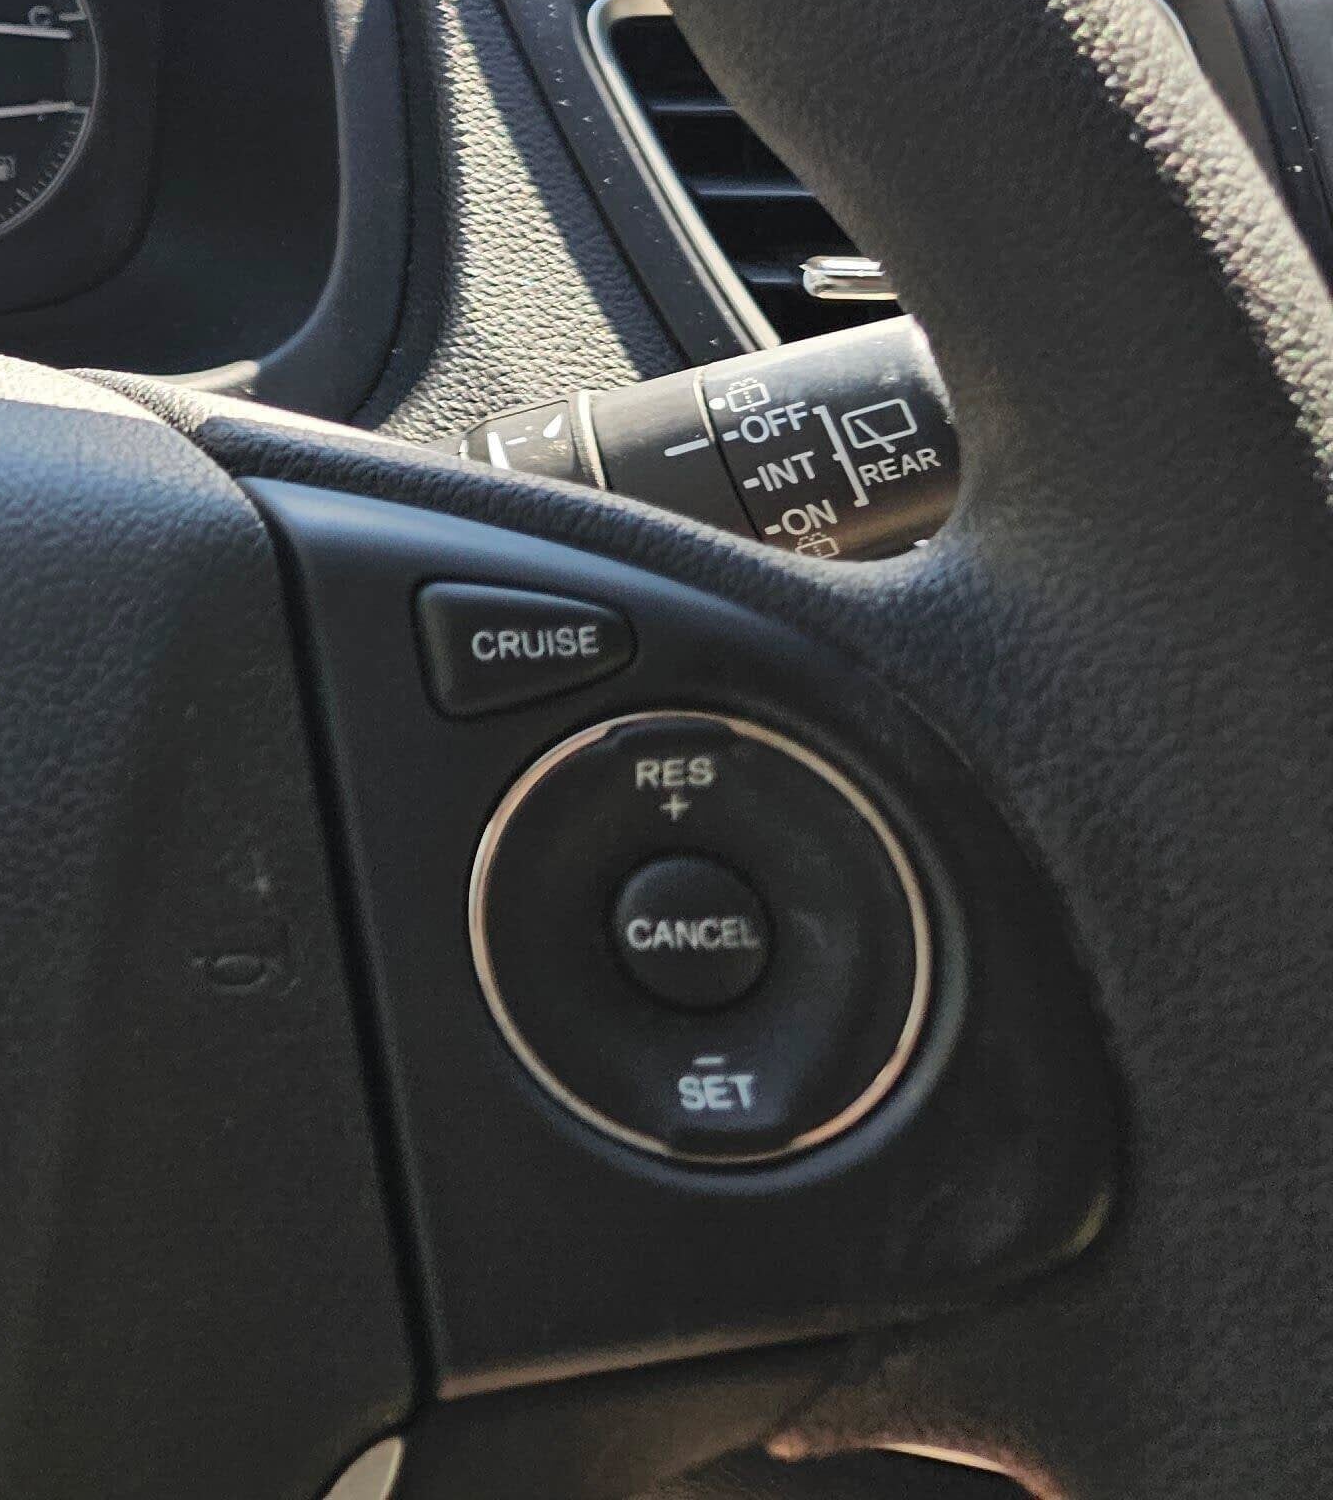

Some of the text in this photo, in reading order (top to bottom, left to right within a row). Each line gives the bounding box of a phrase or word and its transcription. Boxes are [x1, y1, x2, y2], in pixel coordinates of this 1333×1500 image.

[740, 403, 811, 444] OFF
[757, 450, 817, 492] INT
[857, 447, 941, 488] REAR
[781, 499, 837, 536] ON
[471, 625, 600, 662] CRUISE
[635, 756, 715, 788] RES
[626, 916, 760, 952] CANCEL
[678, 1073, 757, 1112] SET
